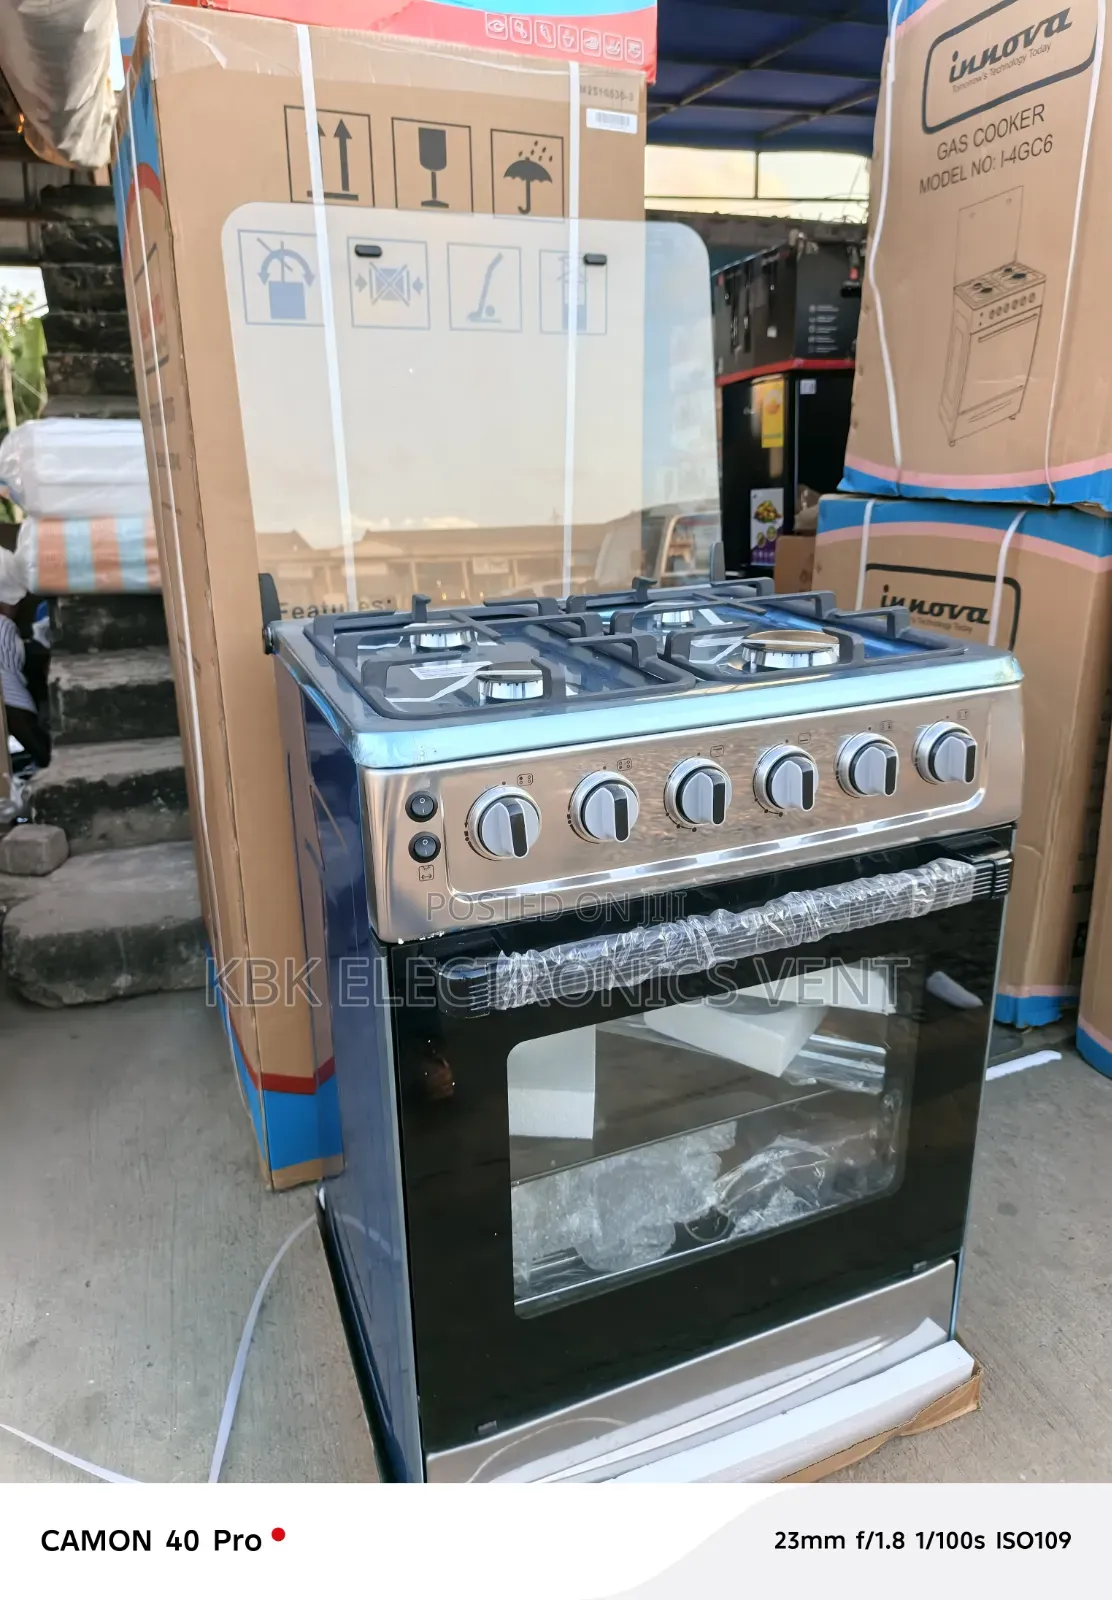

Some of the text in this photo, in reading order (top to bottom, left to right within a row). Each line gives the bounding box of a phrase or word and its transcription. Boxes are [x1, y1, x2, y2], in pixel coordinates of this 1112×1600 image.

[949, 7, 1072, 83] innova
[952, 42, 1052, 93] Tomorrow's Technology Today
[937, 103, 1045, 160] GAS COOKER
[919, 134, 1053, 194] MODEL NO: I-4GC6
[279, 598, 392, 619] Featues:
[881, 584, 990, 625] innova
